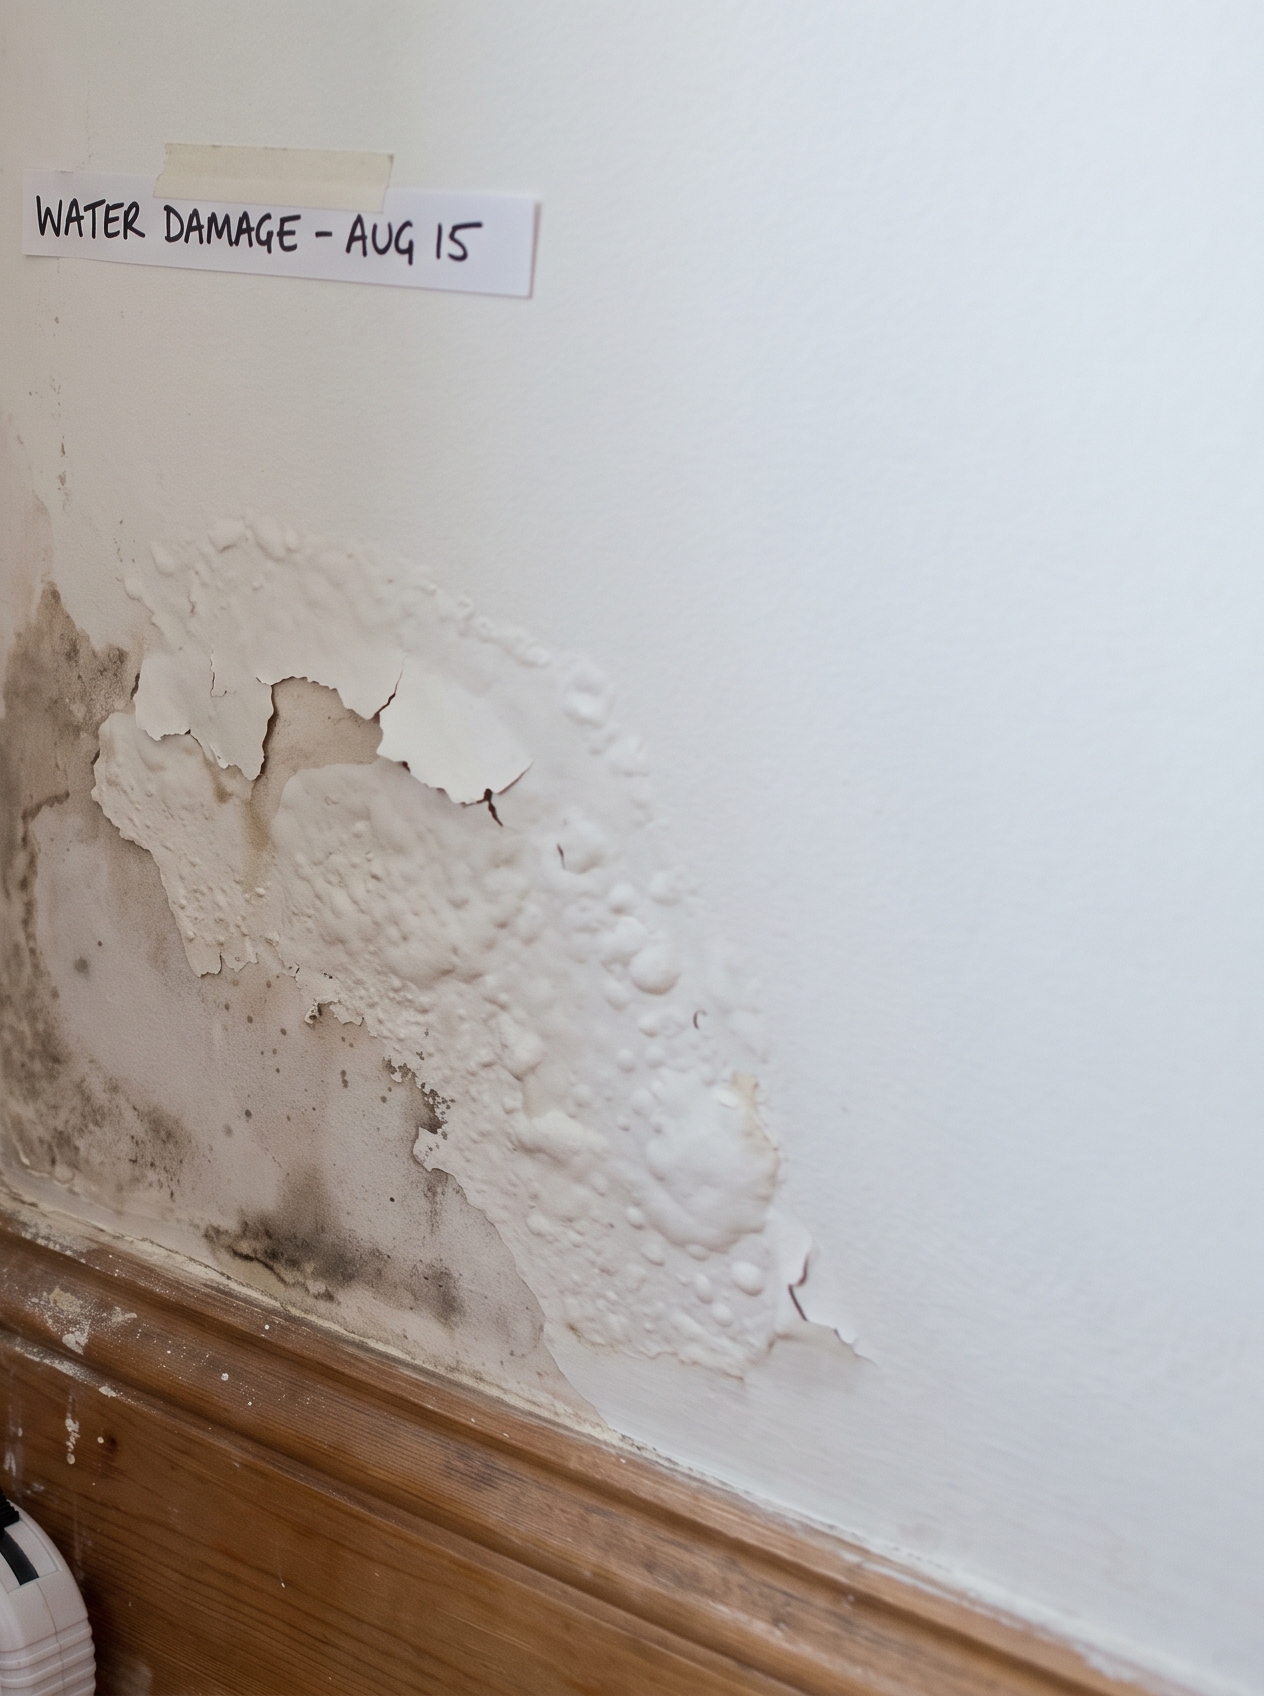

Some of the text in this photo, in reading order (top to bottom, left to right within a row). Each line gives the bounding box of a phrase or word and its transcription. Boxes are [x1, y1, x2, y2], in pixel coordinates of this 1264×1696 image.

[35, 194, 146, 241] WATER
[163, 204, 302, 255] DAMAGE
[345, 213, 414, 266] AUG
[435, 221, 484, 263] 15
